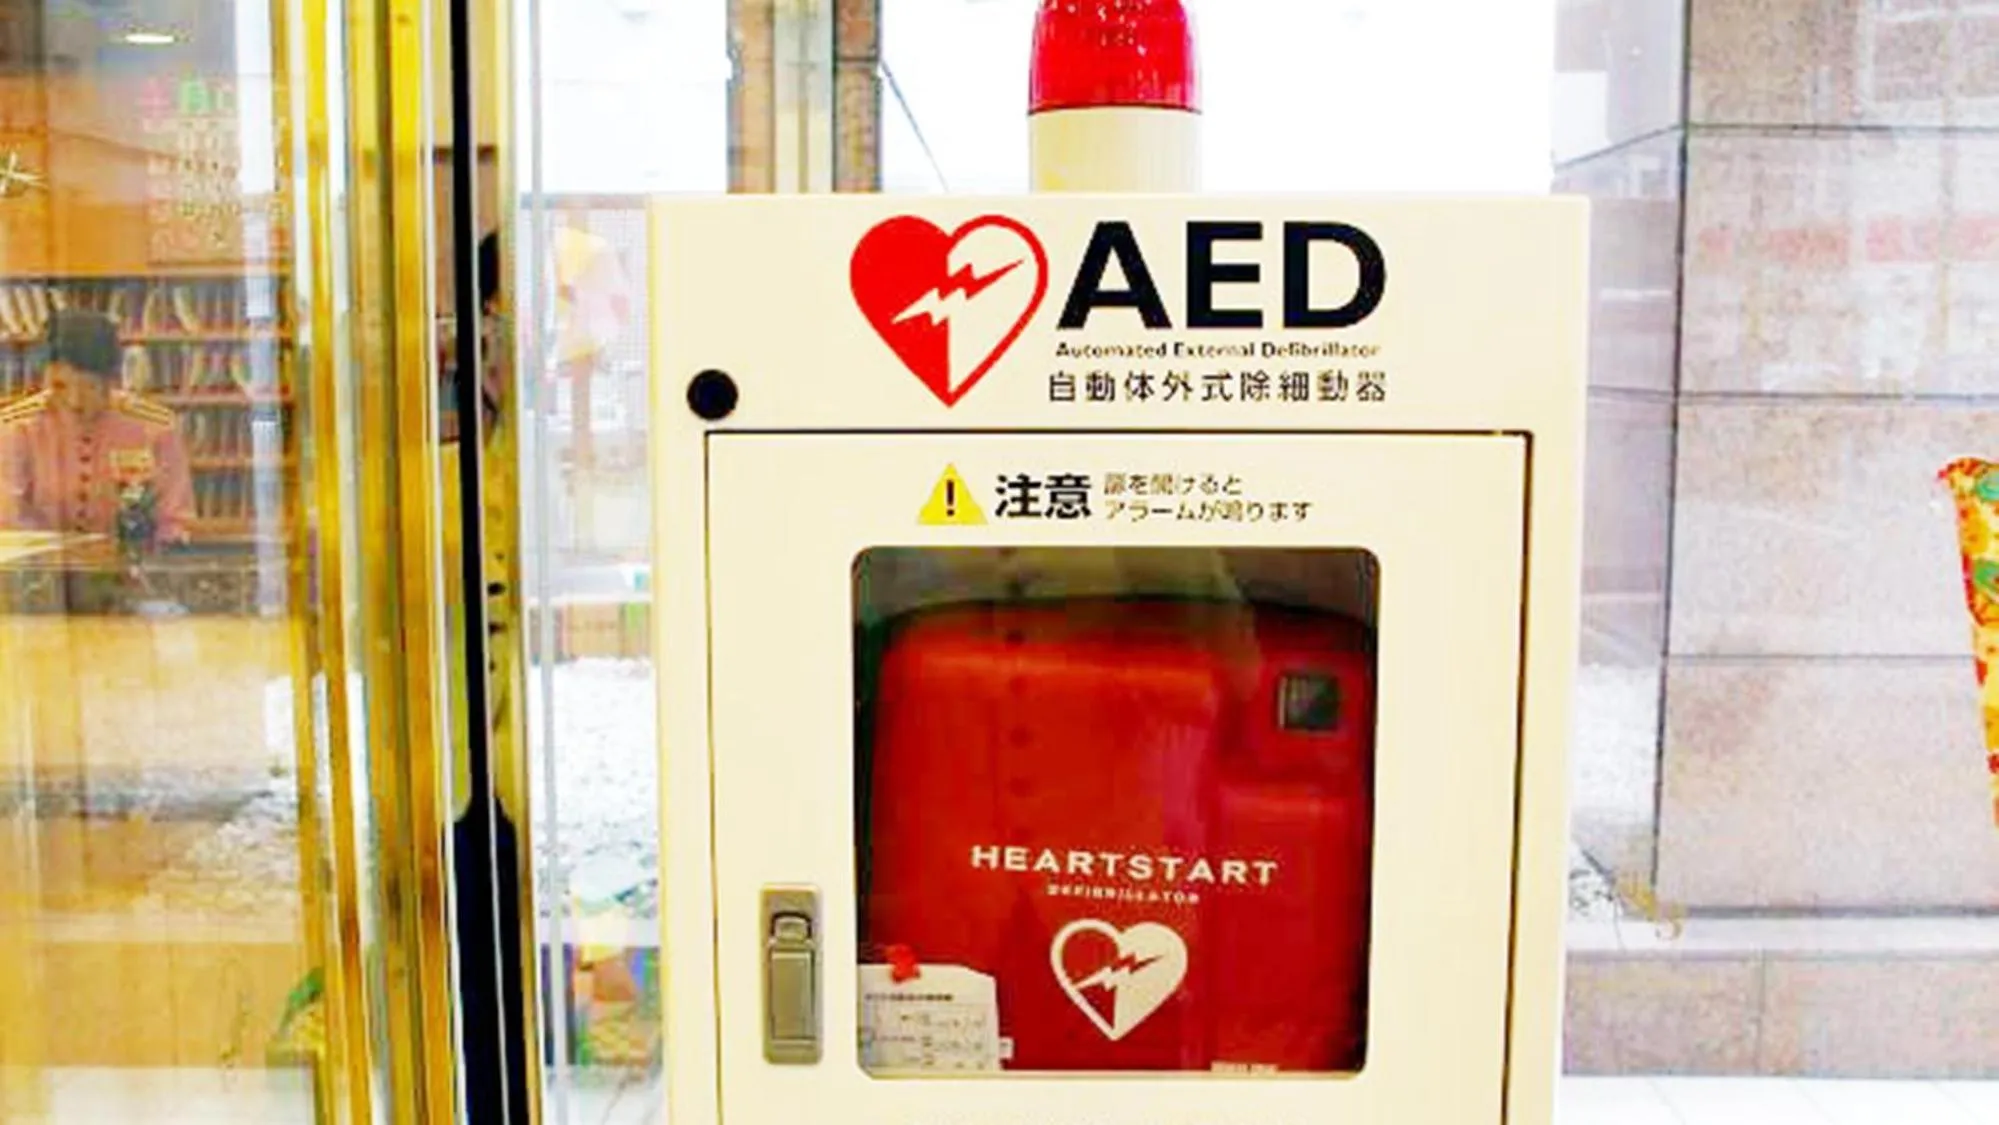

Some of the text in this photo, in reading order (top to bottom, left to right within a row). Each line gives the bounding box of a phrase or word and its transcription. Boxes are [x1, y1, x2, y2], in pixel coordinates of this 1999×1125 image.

[1056, 220, 1388, 330] AED
[1055, 341, 1382, 360] Automated External Defibrillator
[1048, 369, 1387, 403] 自動体外式除細動器
[994, 471, 1093, 522] 注意
[971, 844, 1278, 887] HEARTSTART
